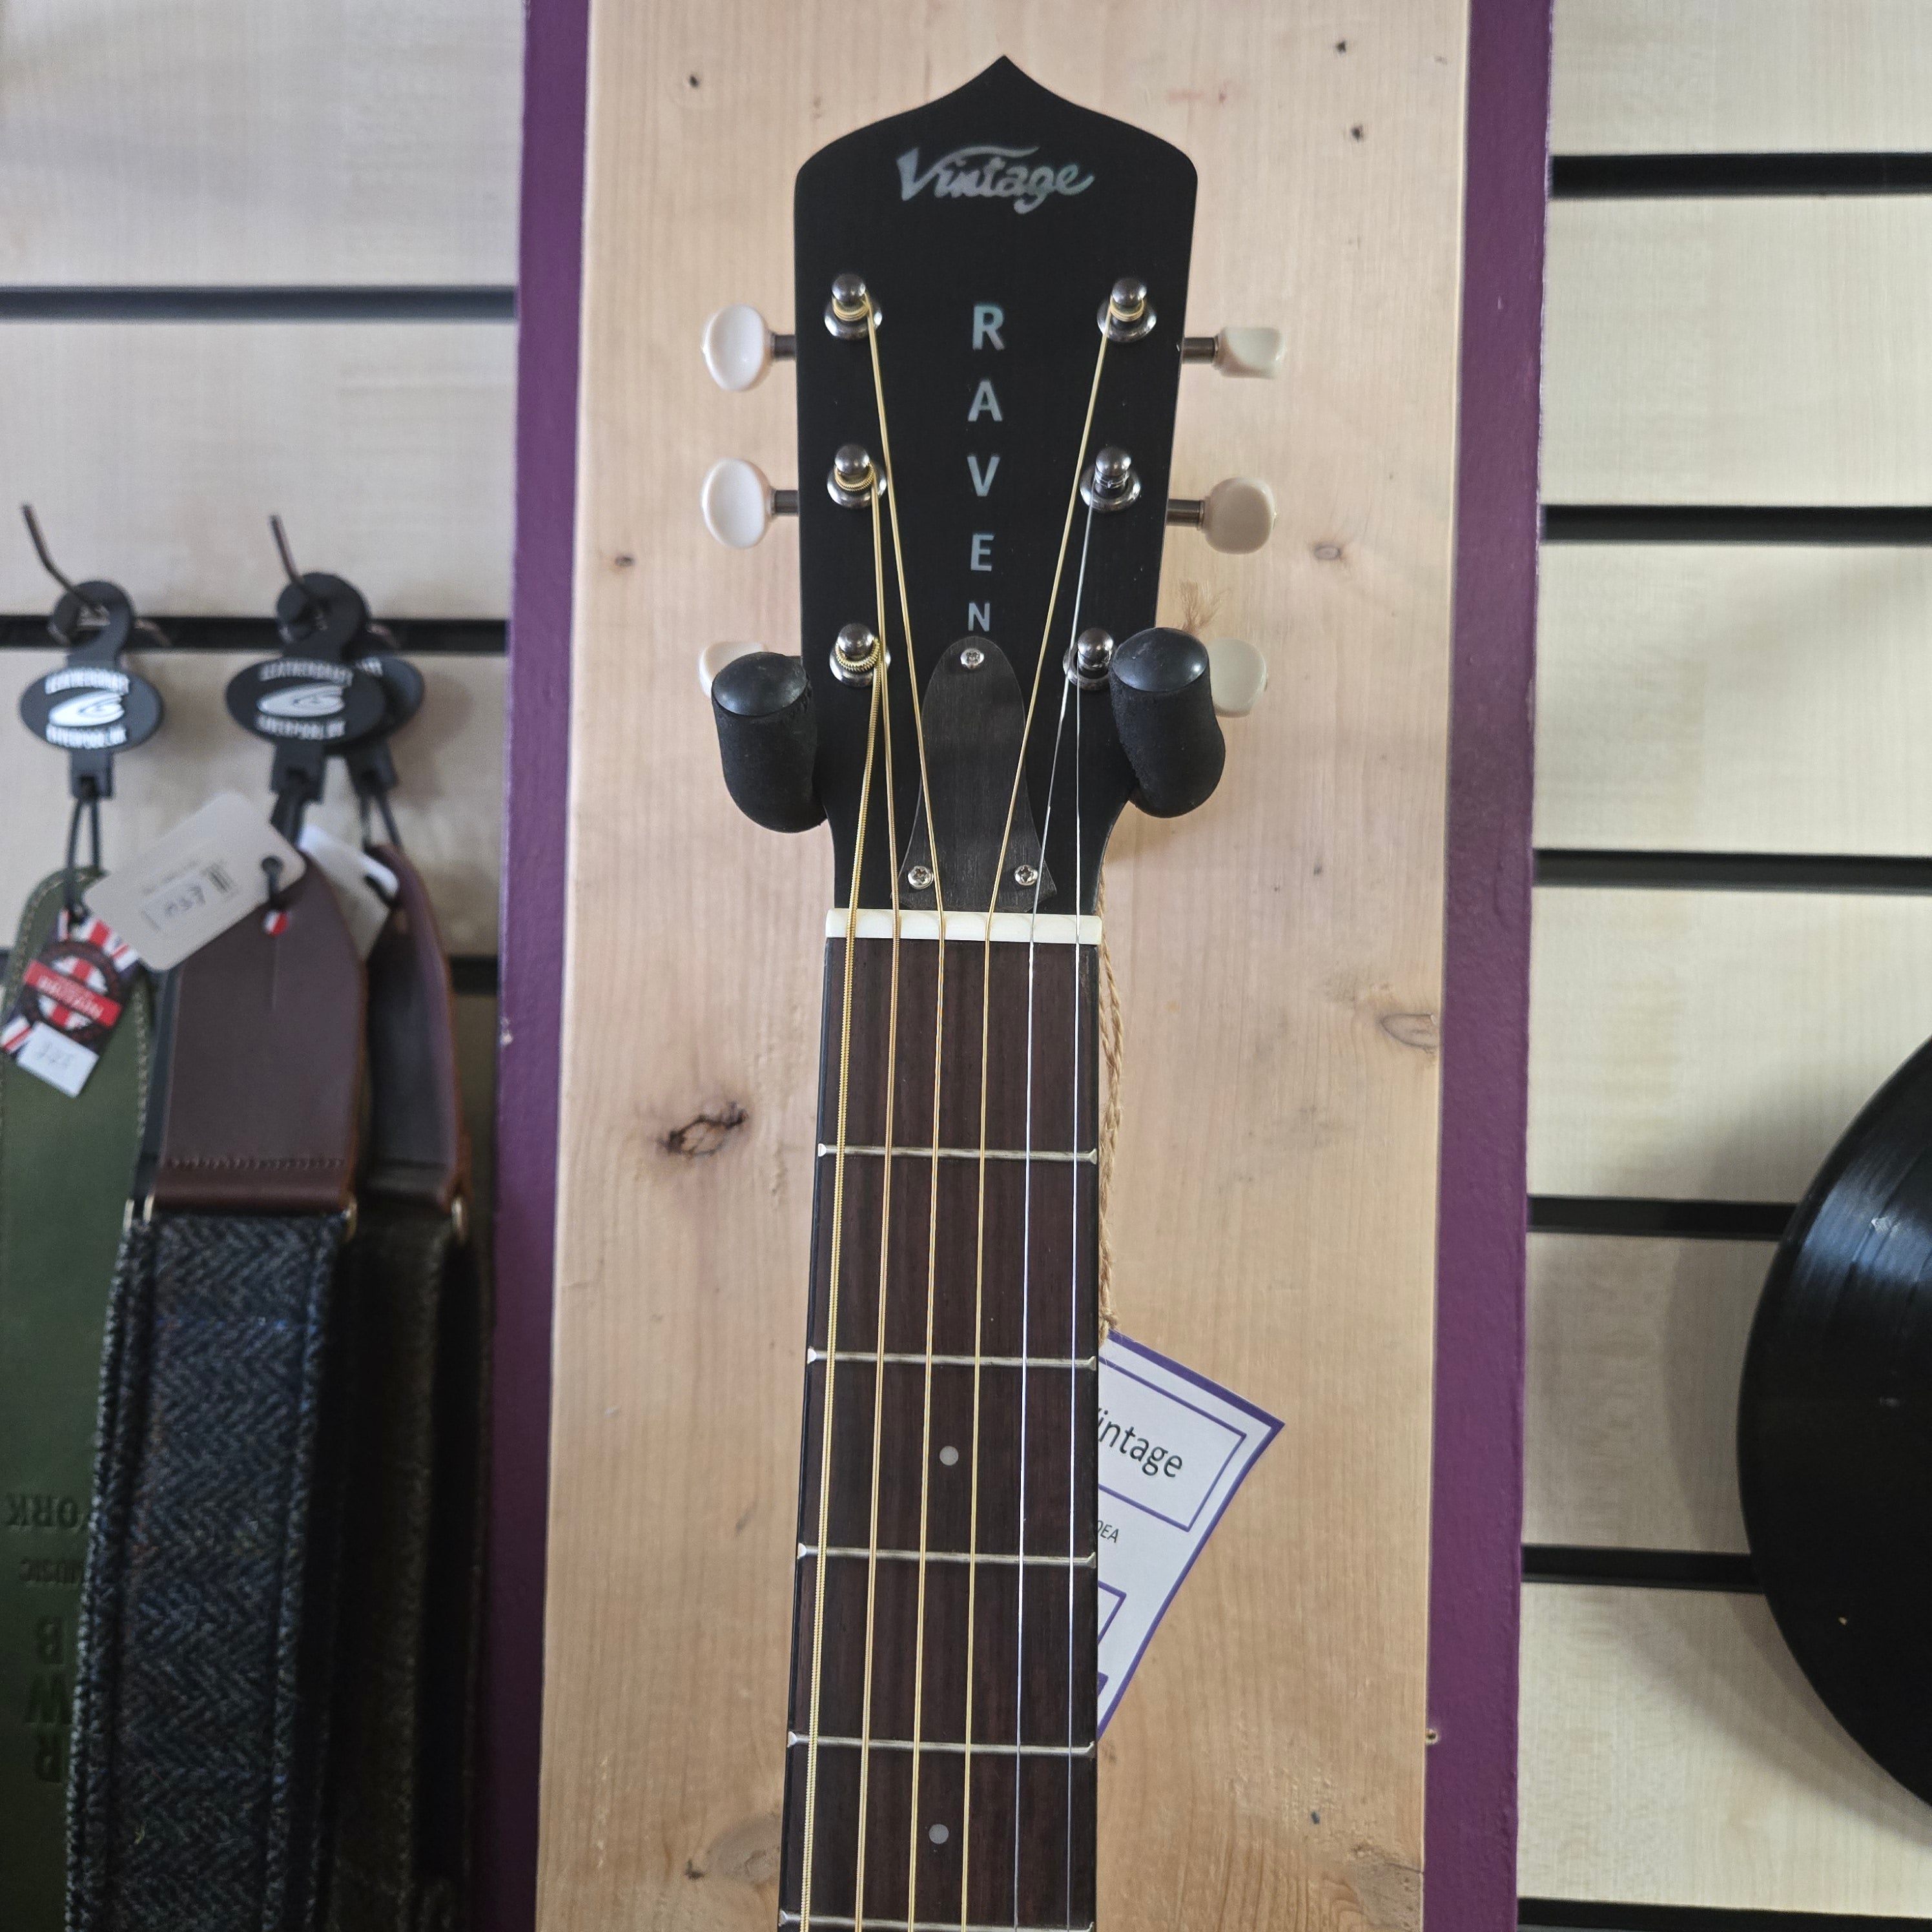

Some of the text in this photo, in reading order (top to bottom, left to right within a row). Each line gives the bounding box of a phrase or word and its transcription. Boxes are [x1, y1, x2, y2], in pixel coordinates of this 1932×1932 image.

[896, 147, 1096, 215] Vintage
[967, 302, 1005, 633] RAVEN
[1098, 1408, 1183, 1479] intage
[5, 1493, 90, 1530] ORK
